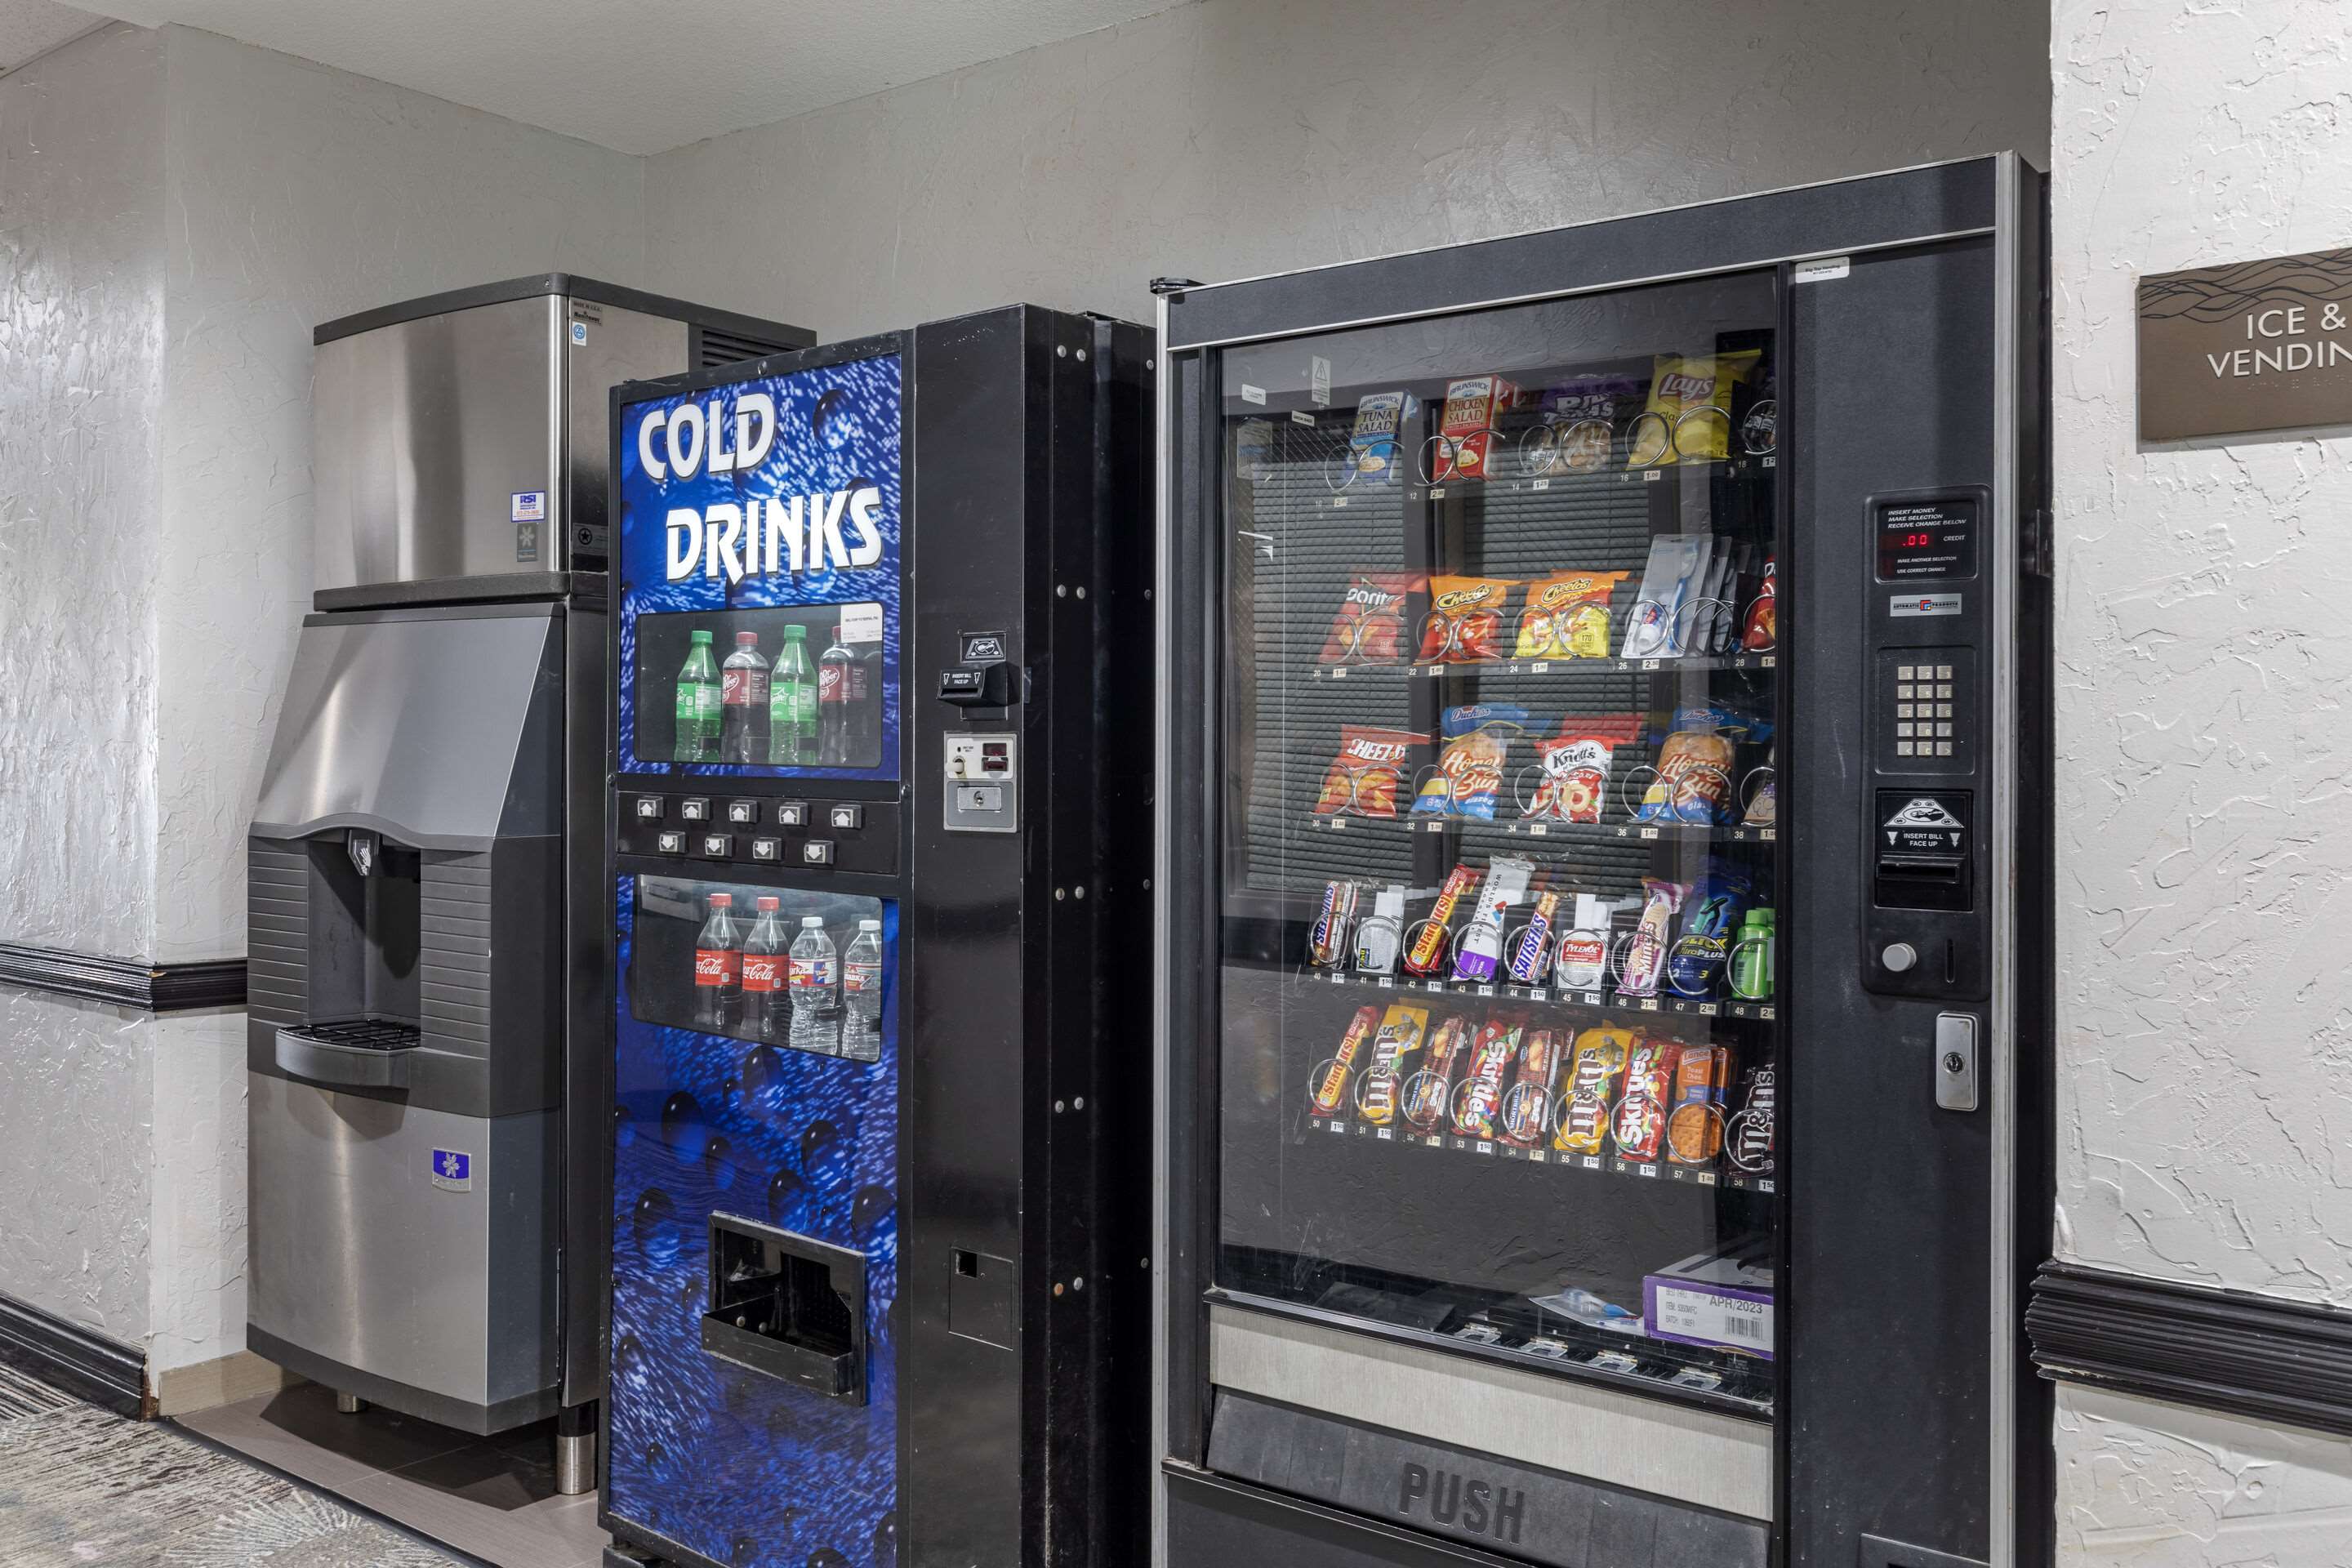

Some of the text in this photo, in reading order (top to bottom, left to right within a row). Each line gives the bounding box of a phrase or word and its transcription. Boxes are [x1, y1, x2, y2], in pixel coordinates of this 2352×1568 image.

[2247, 303, 2346, 340] ICE &
[2207, 340, 2352, 378] VENDIN
[1450, 381, 1489, 395] BRUNSWICK
[1361, 395, 1399, 408] BRUNSWICK
[1449, 398, 1485, 412] CHICKEN
[1363, 410, 1392, 422] TUNA
[1448, 410, 1483, 423] SALAD
[1359, 421, 1392, 432] SALAD
[639, 393, 775, 480] COLD
[666, 488, 883, 586] DRINKS
[1542, 579, 1592, 603] Cheetos
[1552, 747, 1596, 768] Knott's
[1663, 754, 1731, 779] Honey
[1454, 770, 1501, 796] Bun
[1675, 773, 1722, 800] Bun
[1486, 874, 1502, 909] WORLD'S
[1316, 884, 1334, 946] SNICKERS
[1566, 943, 1598, 954] TYLENOL
[1673, 969, 1680, 978] 2
[1699, 970, 1708, 978] 3
[1683, 1049, 1712, 1060] Lance
[1686, 1066, 1704, 1074] Toast
[1674, 1170, 1683, 1178] 57
[1709, 1295, 1762, 1314] APR/2023
[1398, 1462, 1525, 1546] PUSH
